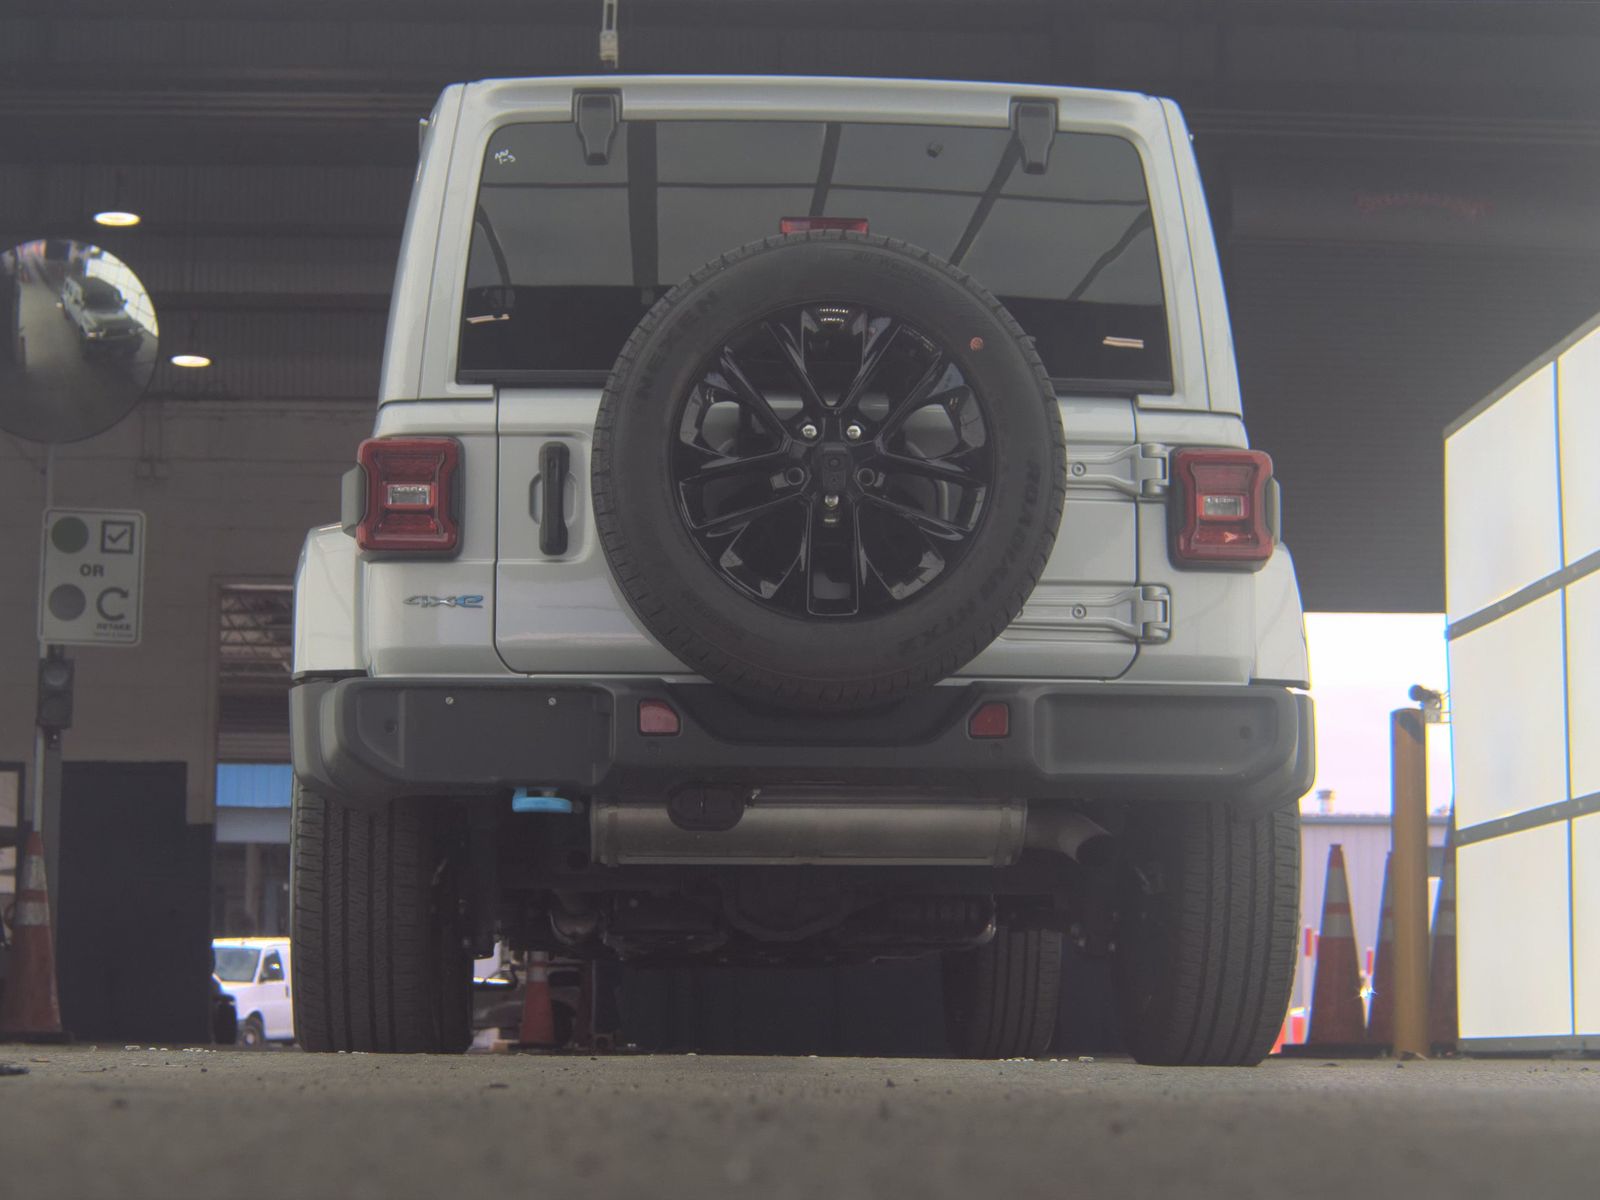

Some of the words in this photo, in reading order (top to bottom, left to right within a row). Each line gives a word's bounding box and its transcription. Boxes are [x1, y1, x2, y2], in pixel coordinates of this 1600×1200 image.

[635, 289, 721, 399] NEXEN
[80, 563, 104, 577] OR
[96, 622, 132, 631] RETAKE
